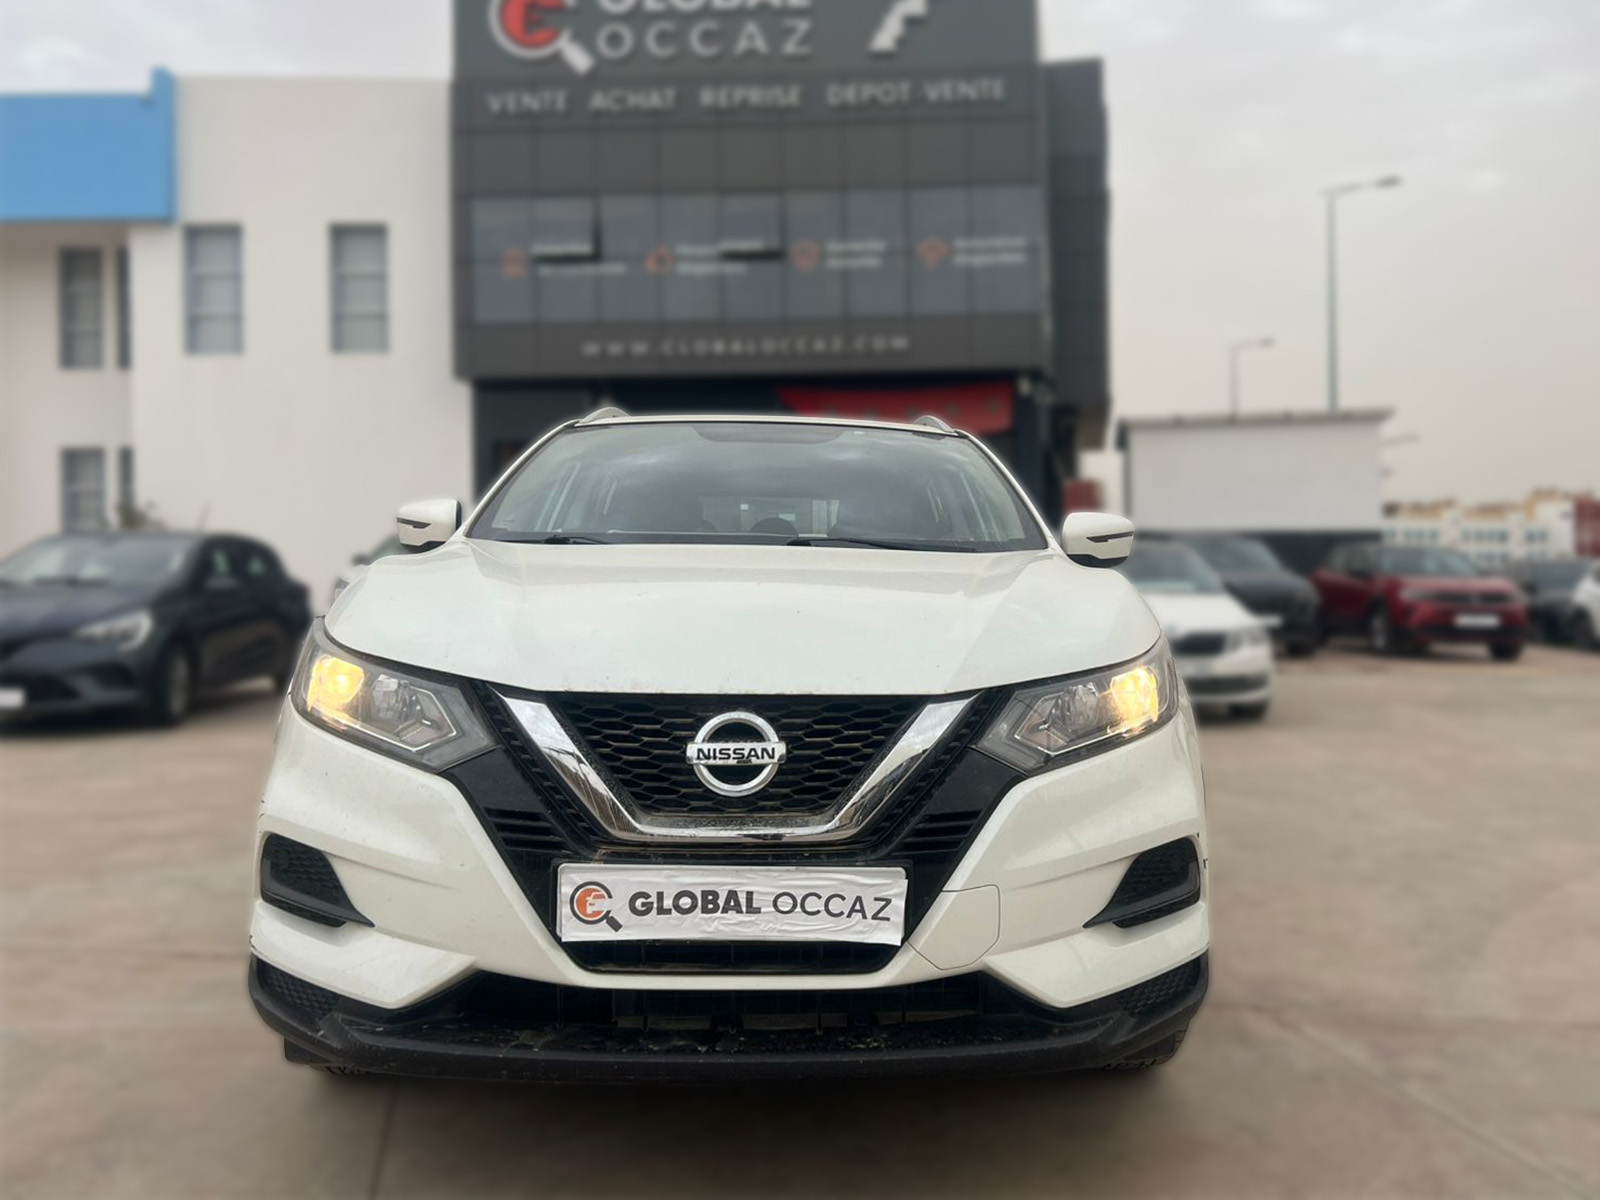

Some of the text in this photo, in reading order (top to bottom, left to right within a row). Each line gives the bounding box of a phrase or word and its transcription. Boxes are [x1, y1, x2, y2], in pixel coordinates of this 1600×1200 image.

[596, 19, 813, 59] OCCAZ
[486, 76, 1006, 114] VENTE ACHAT REPRISE DEPOT VENTE
[696, 747, 776, 762] NISSAN
[628, 890, 892, 922] GLOBAL OCCAZ
